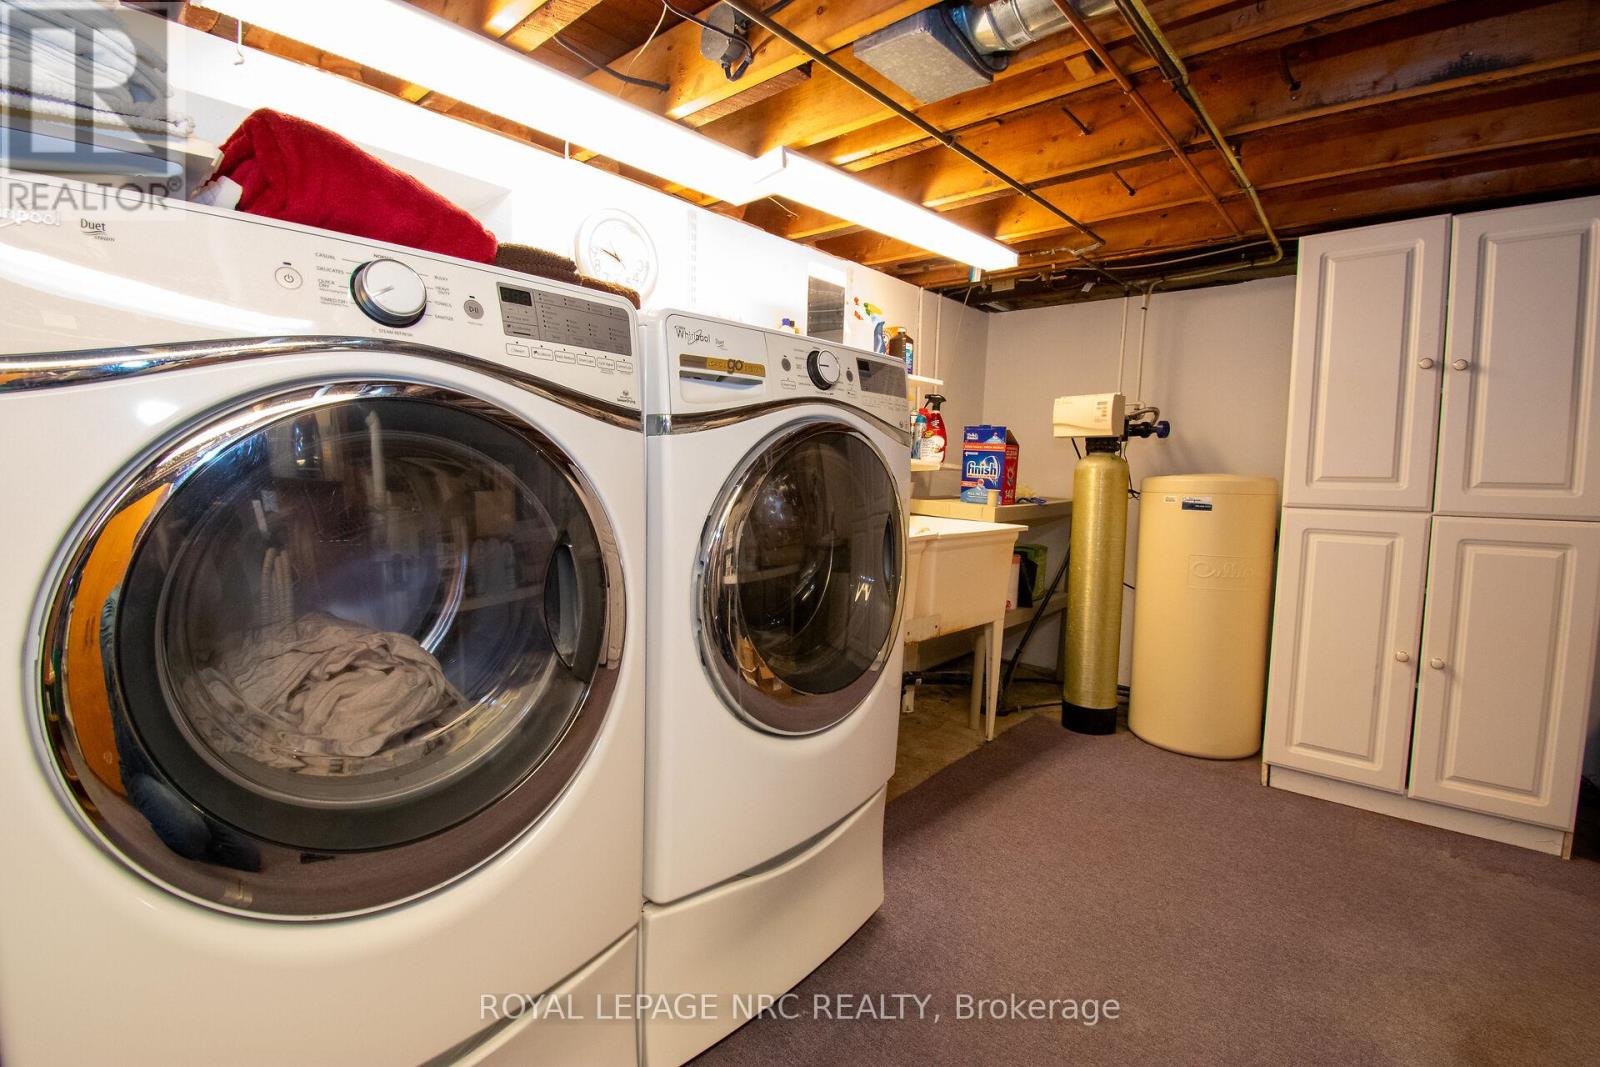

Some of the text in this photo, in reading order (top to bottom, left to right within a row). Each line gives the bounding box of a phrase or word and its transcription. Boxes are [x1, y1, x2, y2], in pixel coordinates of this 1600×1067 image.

[80, 218, 106, 232] Duet
[674, 326, 711, 345] Whirlpool
[967, 460, 997, 475] finish
